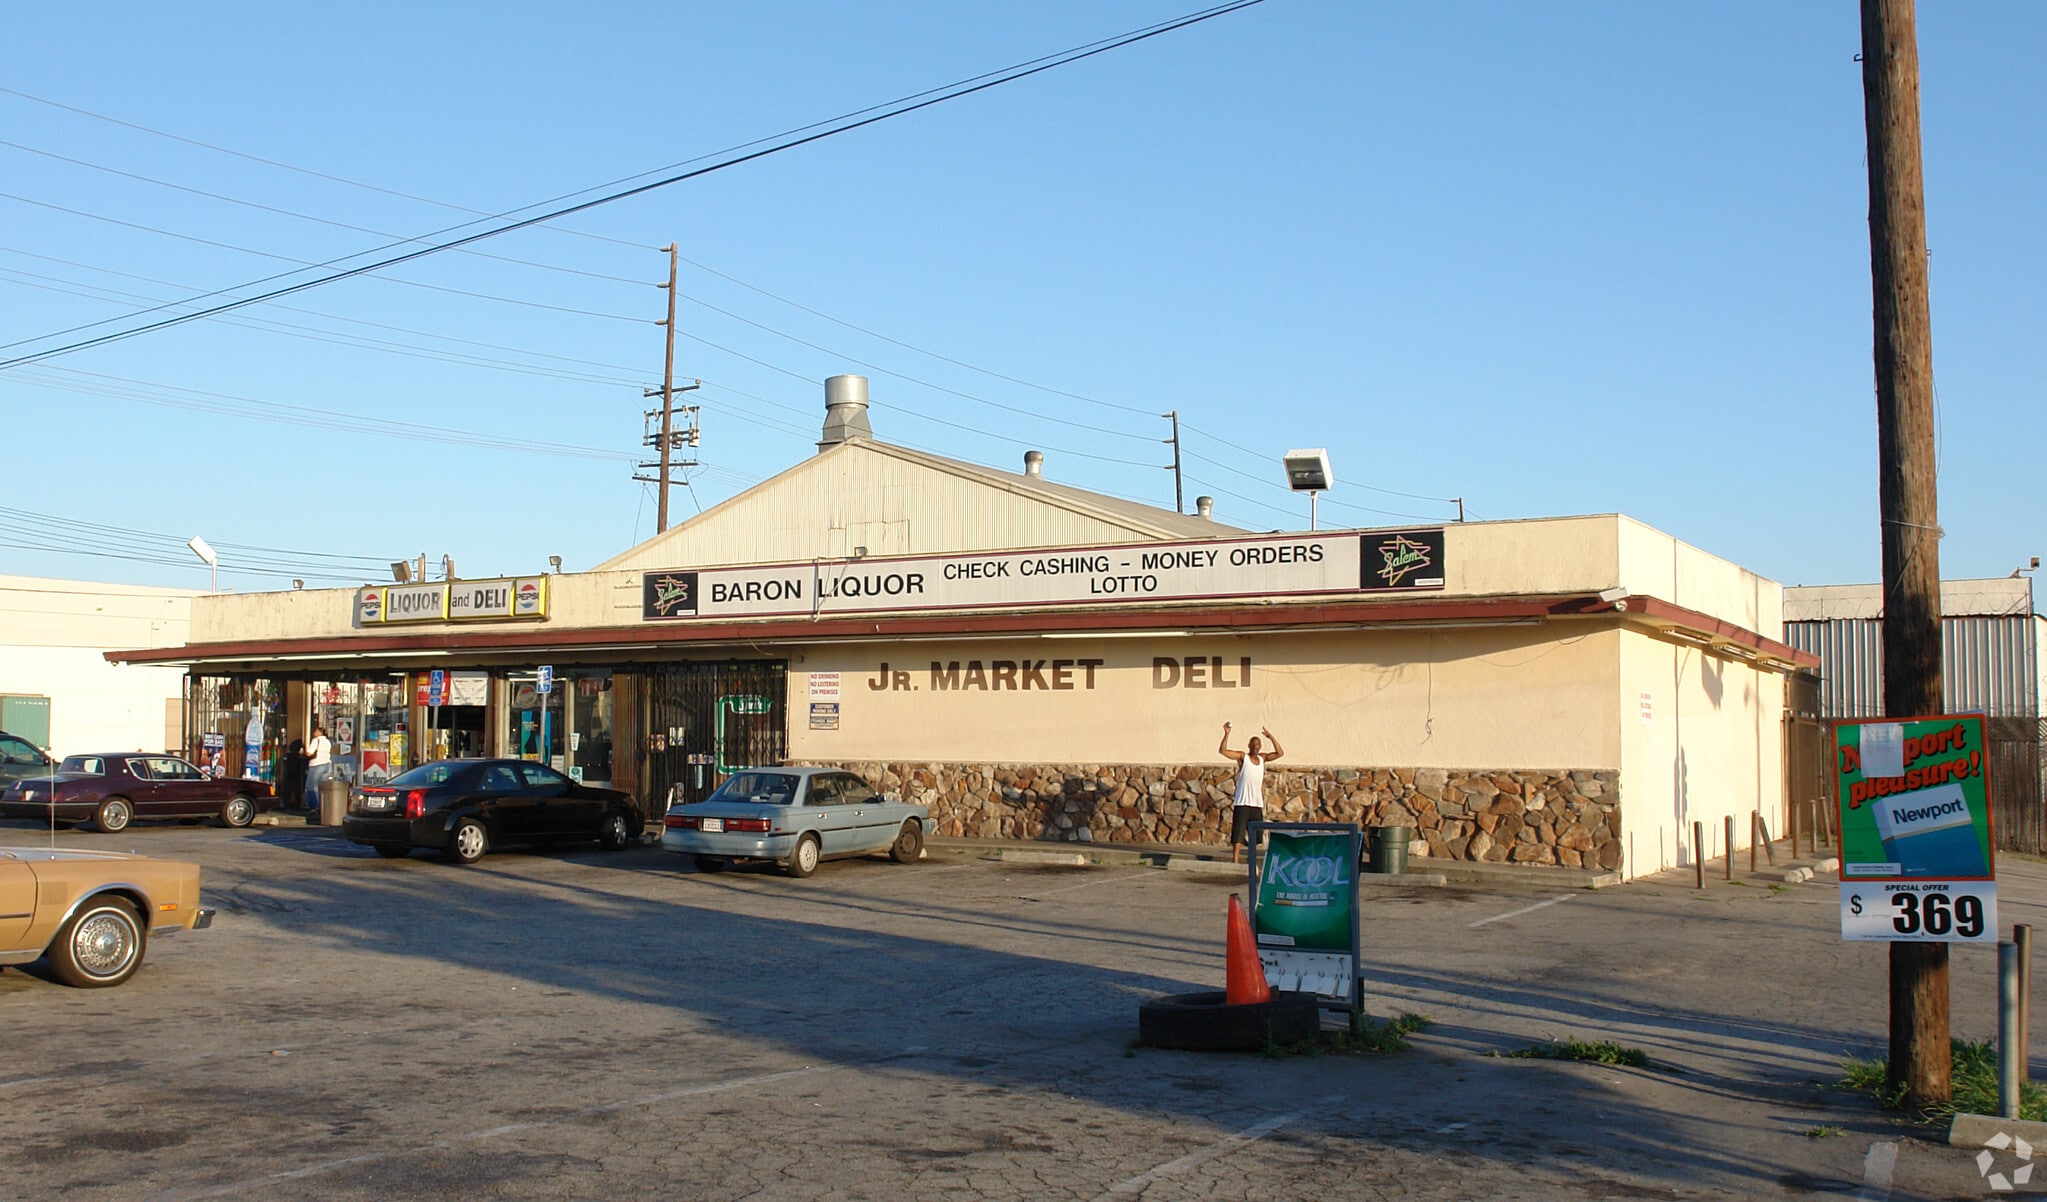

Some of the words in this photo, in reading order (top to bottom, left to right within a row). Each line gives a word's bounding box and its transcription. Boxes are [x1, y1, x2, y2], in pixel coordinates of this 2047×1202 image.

[943, 561, 1010, 580] CHECK
[1020, 556, 1109, 576] CASHING
[1142, 550, 1219, 570] MONEY
[1230, 544, 1324, 566] ORDERS
[1384, 544, 1430, 569] Salem
[711, 580, 802, 603] BARON
[817, 573, 924, 598] LIQUOR
[1091, 575, 1158, 594] LOTTO
[390, 591, 441, 614] LIQUOR
[451, 592, 470, 608] and
[474, 588, 507, 609] DELI
[930, 659, 1104, 691] MARKET
[1152, 656, 1251, 689] DELI
[1839, 722, 1966, 774] Nport
[1848, 750, 1981, 810] pleasure!
[1892, 798, 1964, 824] Newport
[1266, 853, 1350, 888] KOOL
[1850, 893, 1863, 917] $
